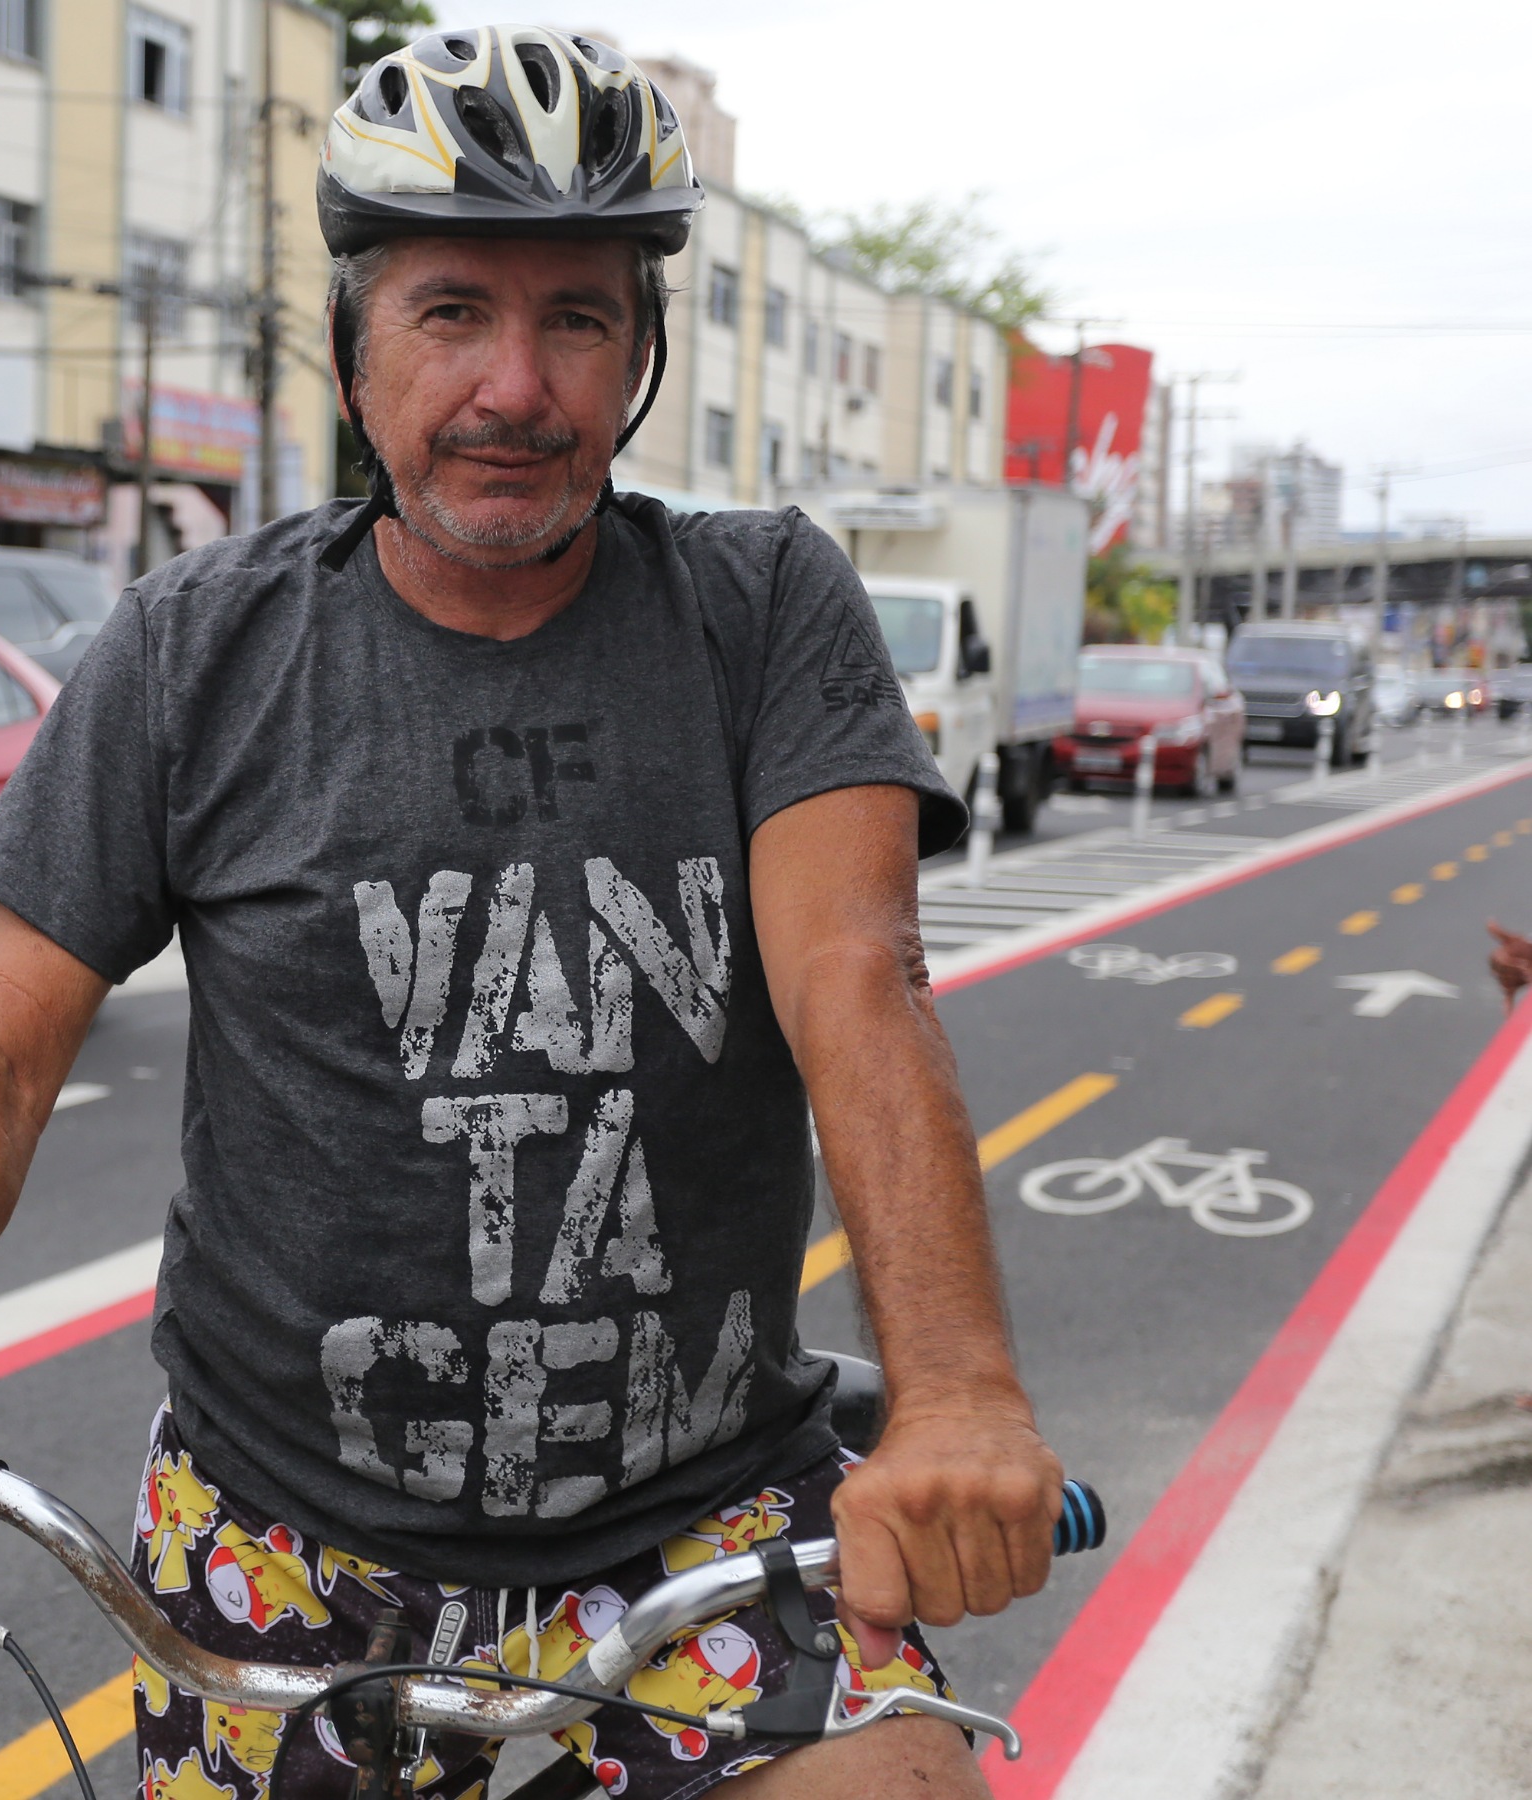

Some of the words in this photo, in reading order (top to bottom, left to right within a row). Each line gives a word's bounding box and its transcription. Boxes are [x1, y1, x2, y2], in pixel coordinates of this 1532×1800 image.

[453, 724, 595, 826] CF
[821, 682, 903, 712] SAFE
[353, 856, 731, 1080] VAN
[421, 1089, 672, 1306] TA
[321, 1289, 755, 1518] GEM
